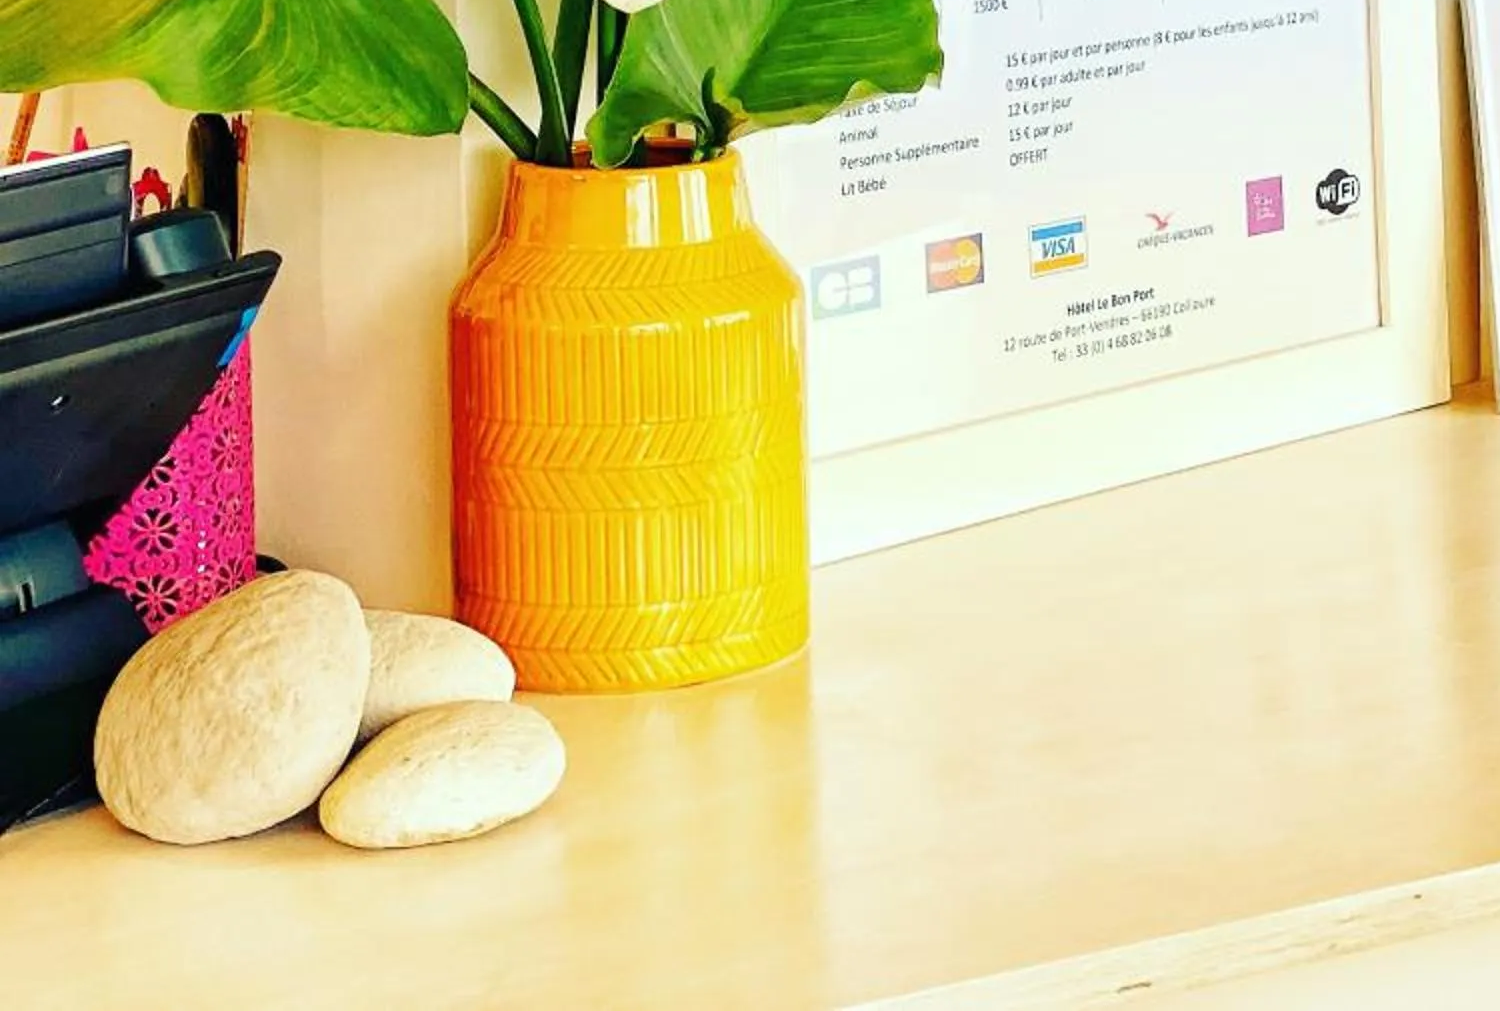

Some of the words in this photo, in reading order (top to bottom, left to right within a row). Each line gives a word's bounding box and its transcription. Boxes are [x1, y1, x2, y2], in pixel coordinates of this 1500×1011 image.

[1006, 52, 1019, 68] 15
[1029, 50, 1047, 66] par
[1049, 47, 1070, 65] jour
[1072, 45, 1083, 58] et
[1085, 42, 1102, 58] par
[1105, 36, 1151, 54] personne
[1286, 11, 1297, 25] 12
[1040, 73, 1057, 89] par
[1059, 68, 1092, 85] adulte
[1107, 63, 1123, 79] par
[1125, 60, 1145, 77] jour
[1008, 102, 1020, 118] 12
[1031, 99, 1049, 115] par
[1051, 96, 1072, 114] jour
[840, 126, 879, 145] Animal
[1009, 126, 1021, 142] 15
[1033, 124, 1050, 141] par
[1053, 121, 1073, 138] jour
[840, 151, 893, 170] Personne
[895, 135, 980, 161] Supplémentaire
[1009, 147, 1047, 167] OFFERT
[841, 181, 855, 197] Lit
[857, 176, 887, 194] Bébé
[1041, 237, 1075, 259] VISA
[1067, 299, 1095, 317] Hôtel
[1097, 297, 1108, 311] Le
[1111, 293, 1131, 309] Bon
[1133, 287, 1155, 304] Port
[1003, 336, 1016, 352] 12
[1019, 332, 1047, 349] route
[1049, 328, 1062, 342] de
[1076, 343, 1089, 359] 33
[1130, 330, 1143, 346] 82
